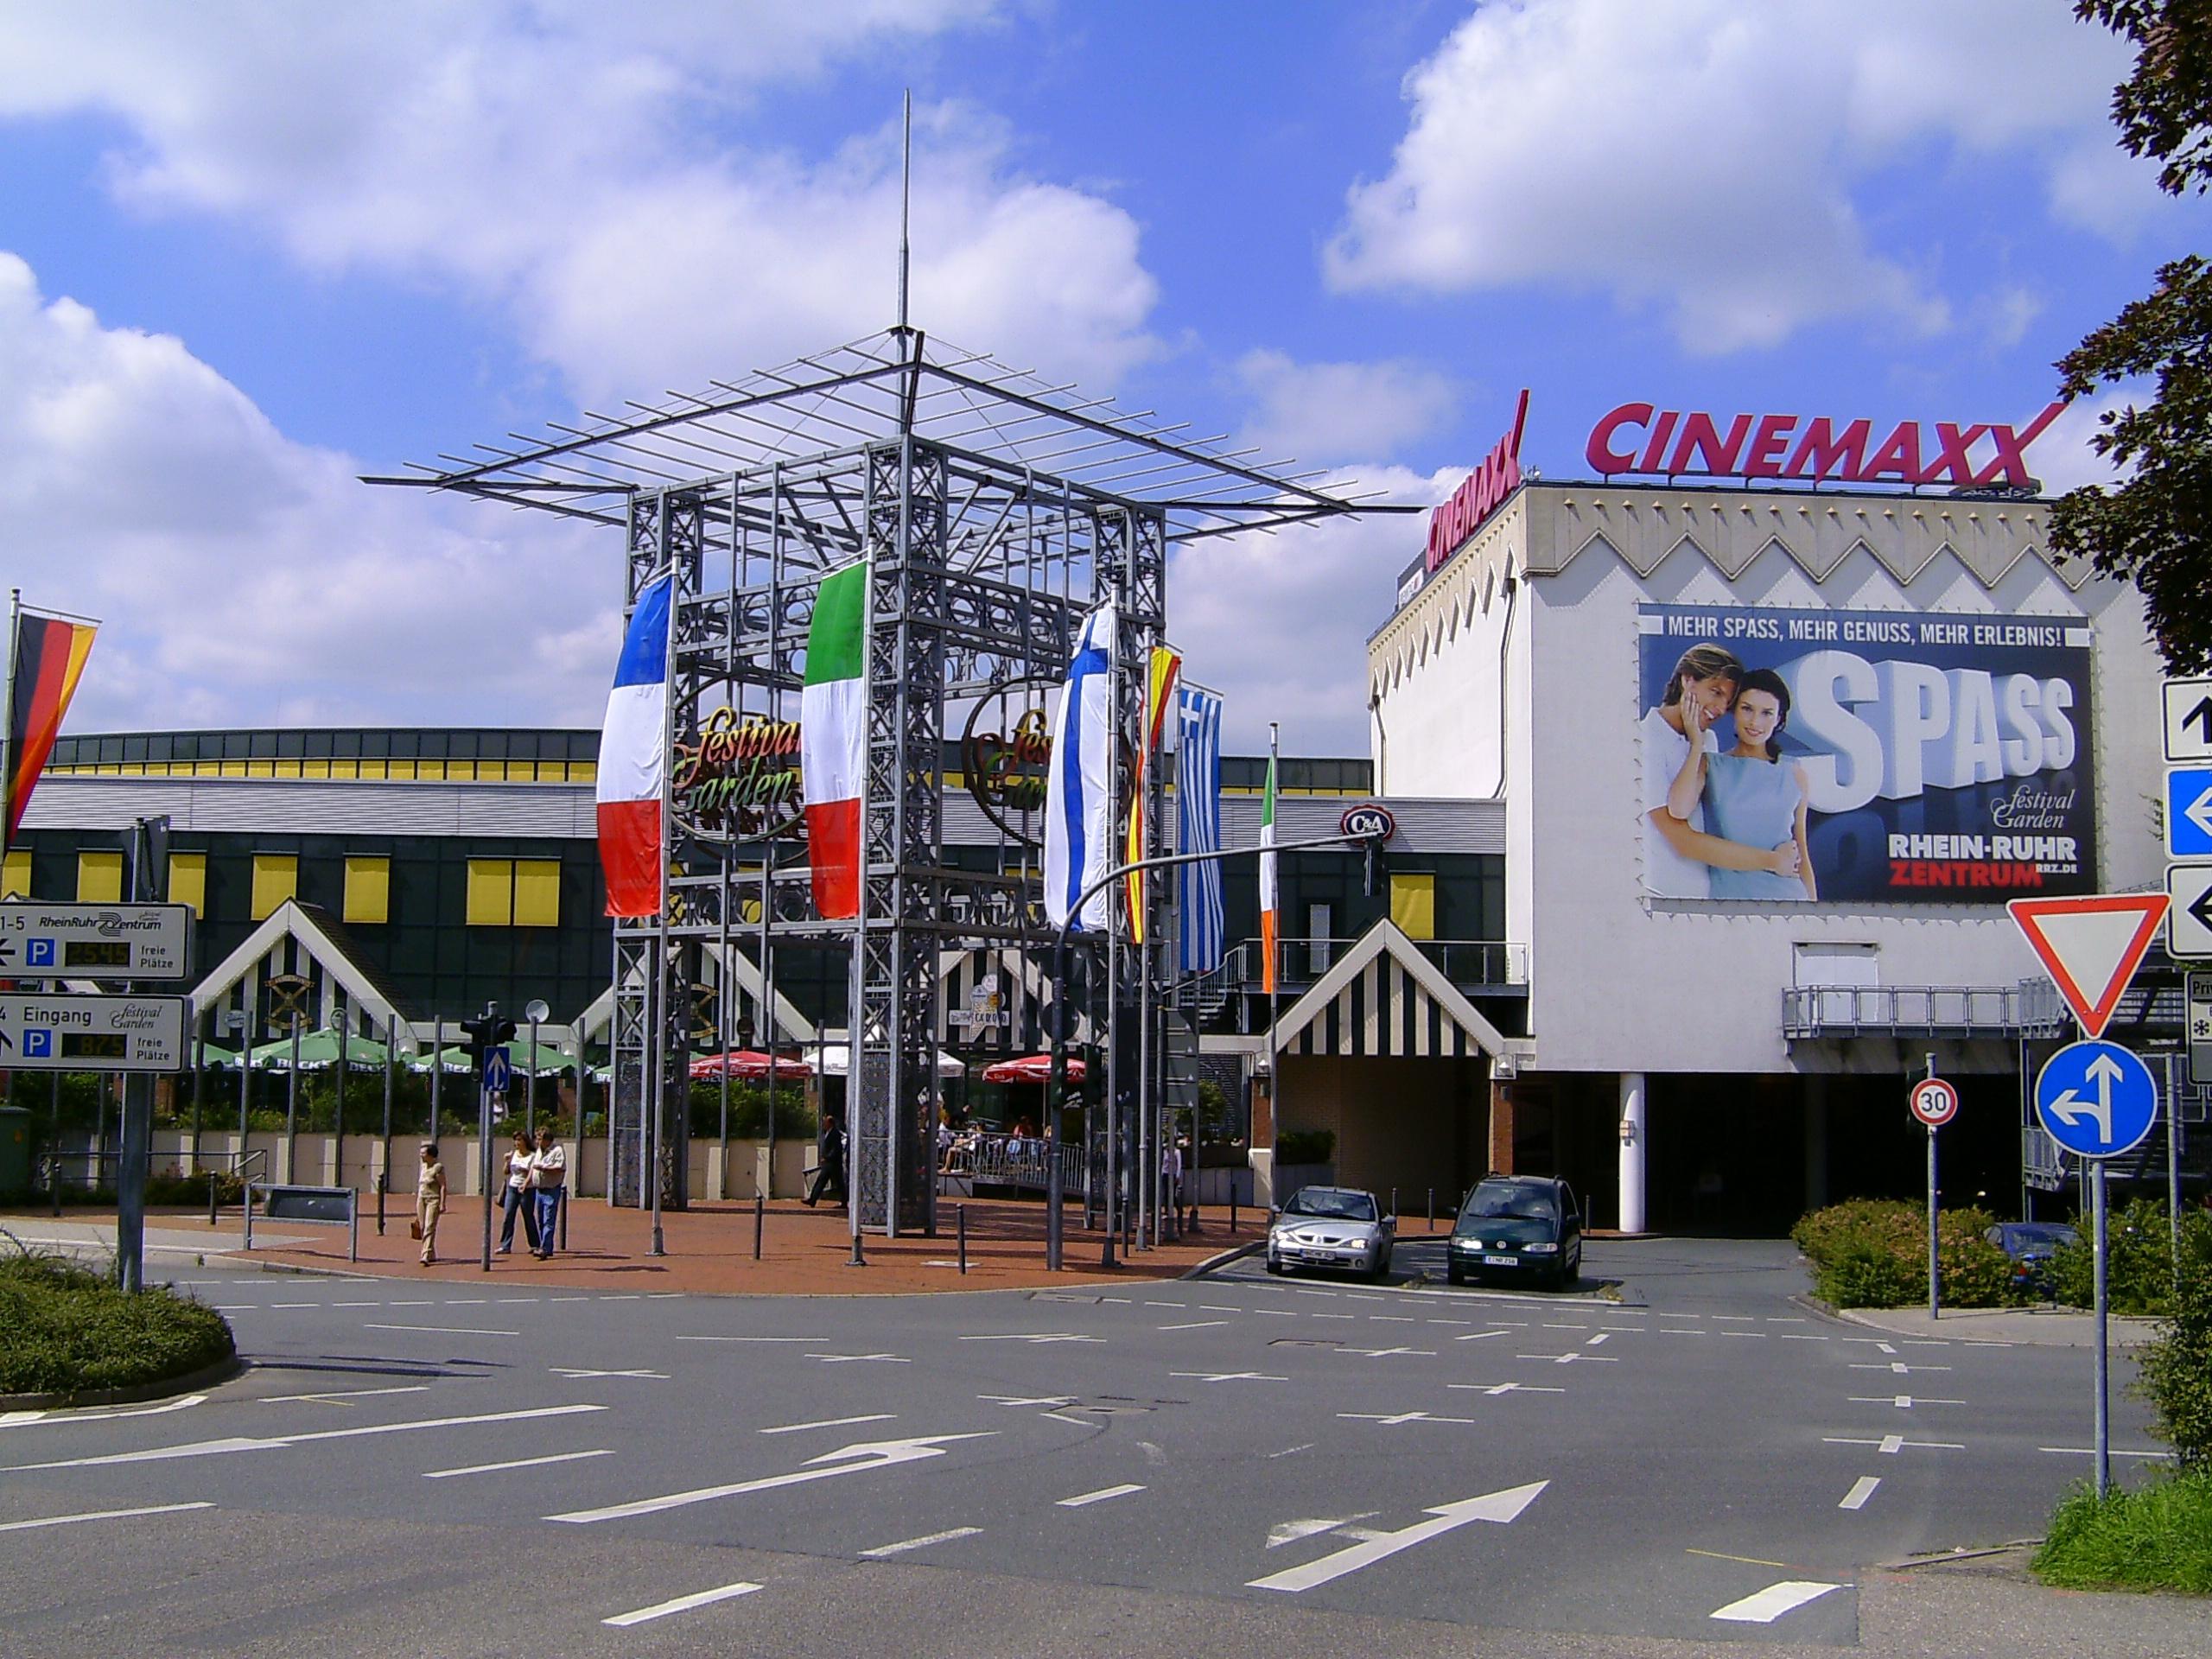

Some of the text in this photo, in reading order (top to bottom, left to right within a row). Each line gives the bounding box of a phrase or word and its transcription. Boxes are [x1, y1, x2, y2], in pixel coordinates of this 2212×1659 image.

[1586, 402, 2069, 486] CINEMAXX
[1425, 388, 1530, 573] CINEMAXX
[1669, 615, 2062, 647] MEHR SPASS, MEHR GENUSS, MEHR ERLEBNIS!
[1782, 650, 2075, 813] SPASS
[1351, 815, 1385, 834] C&A
[1993, 806, 2064, 829] Garden
[1889, 861, 2044, 887] ZENTRUM
[2036, 863, 2077, 874] RRZ.DE
[33, 942, 48, 963] P
[141, 945, 166, 955] freie
[140, 958, 173, 968] Plätze
[23, 1007, 92, 1027] Eingang
[111, 1015, 155, 1028] Garden
[29, 1033, 45, 1054] P
[137, 1038, 162, 1047] freie
[137, 1051, 170, 1060] Plätze
[1921, 1091, 1947, 1112] 30
